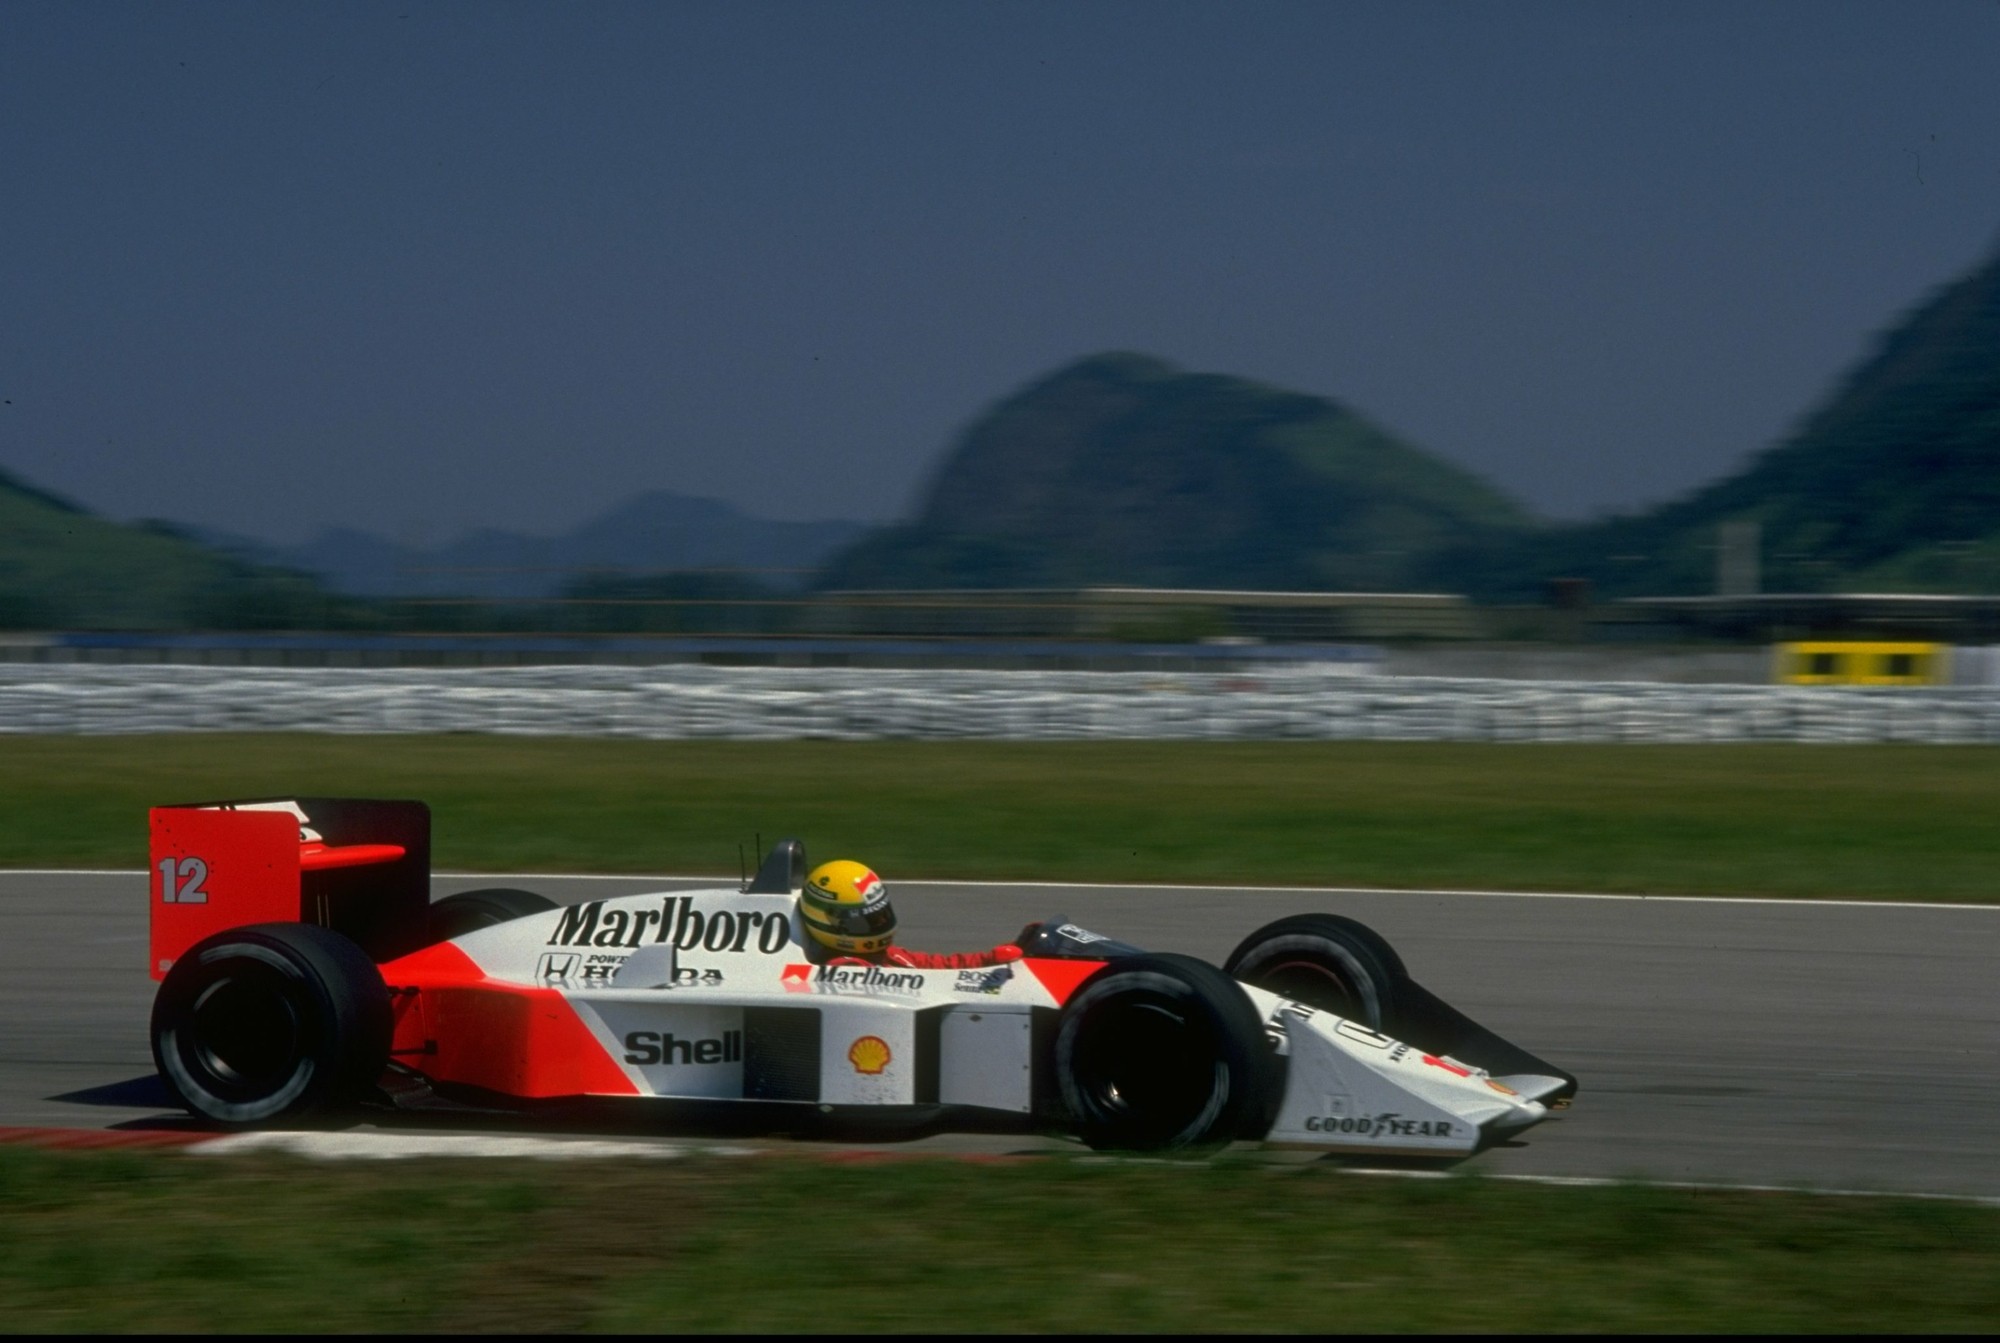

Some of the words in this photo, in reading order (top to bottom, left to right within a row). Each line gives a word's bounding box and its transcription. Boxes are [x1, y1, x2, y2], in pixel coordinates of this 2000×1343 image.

[158, 857, 208, 903] 12
[547, 896, 790, 954] Marlboro
[580, 965, 724, 980] HDA
[814, 964, 924, 990] Marlboro
[624, 1030, 742, 1065] Shell
[1305, 1113, 1453, 1138] GOODYEAR
